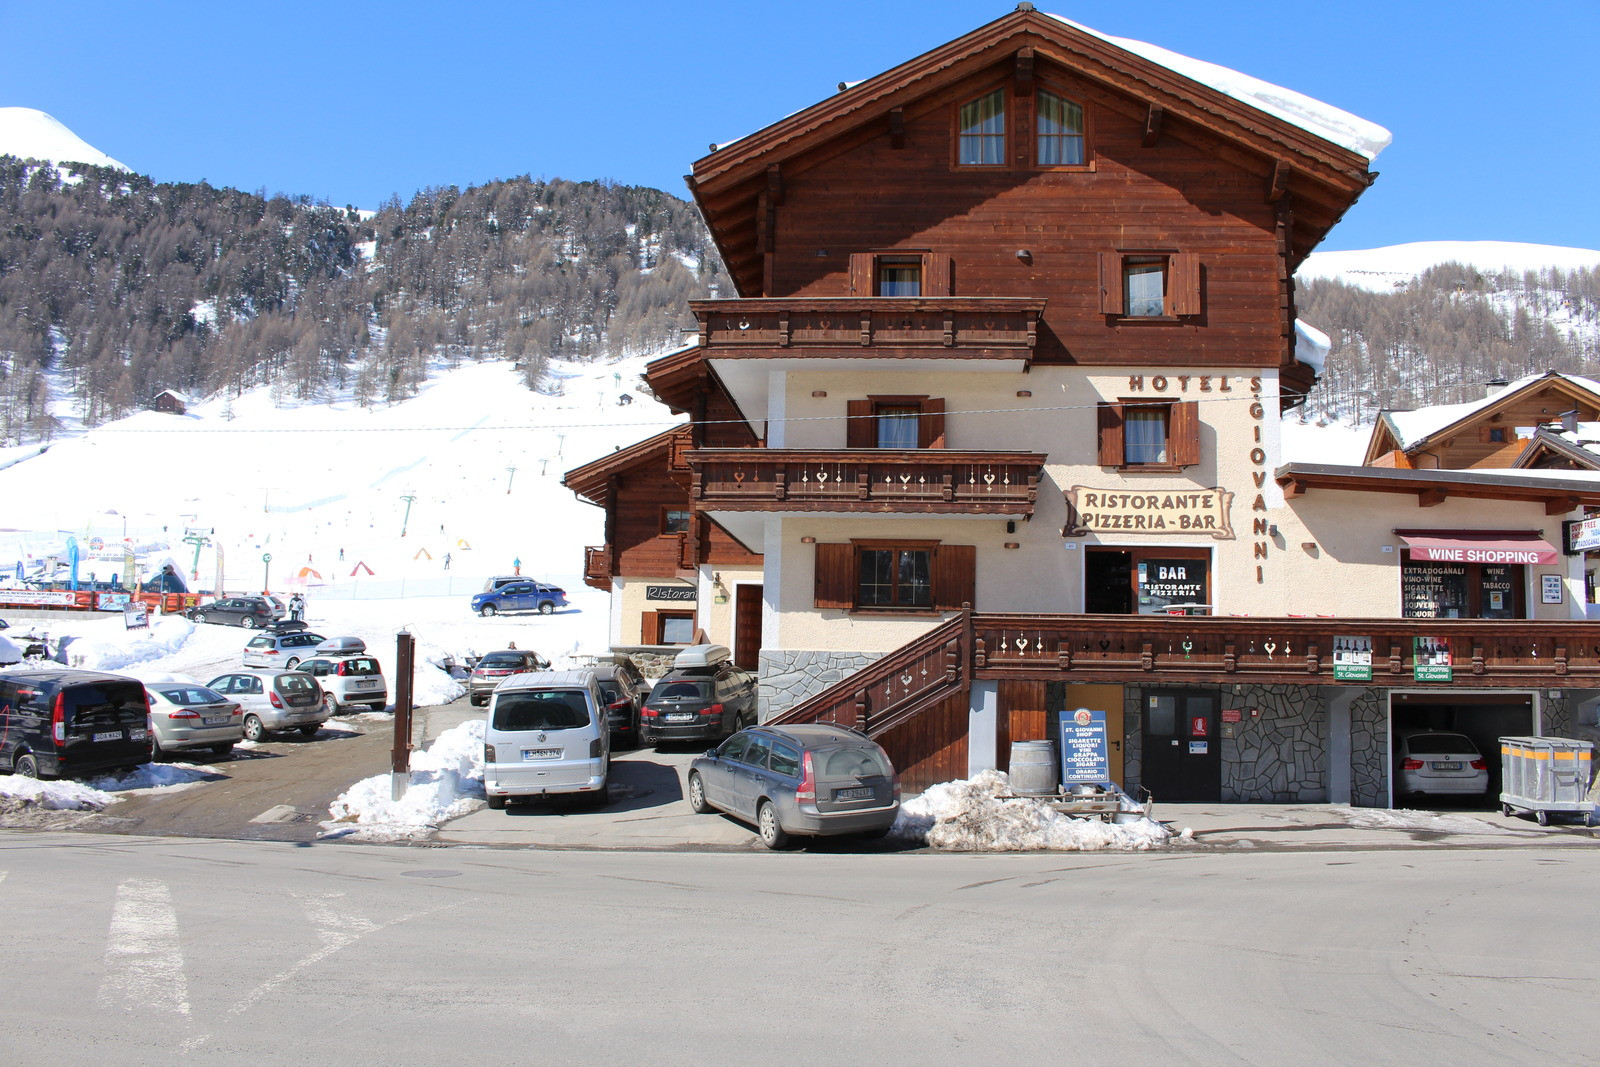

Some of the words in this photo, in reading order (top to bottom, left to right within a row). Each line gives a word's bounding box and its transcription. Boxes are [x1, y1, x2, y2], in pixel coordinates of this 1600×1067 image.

[1128, 375, 1232, 393] HOTEL
[1085, 493, 1214, 510] RISTORANTE
[1082, 513, 1165, 529] PIZZERIA
[1178, 514, 1216, 530] BAR
[1571, 523, 1583, 532] DUTY
[1584, 521, 1597, 530] FREE
[1571, 531, 1584, 540] SHOP
[1428, 548, 1464, 561] WINE
[1467, 550, 1539, 564] SHOPPING
[1159, 566, 1187, 580] BAR
[1404, 584, 1444, 592] SIGARETTE
[1482, 582, 1511, 590] TABACCO
